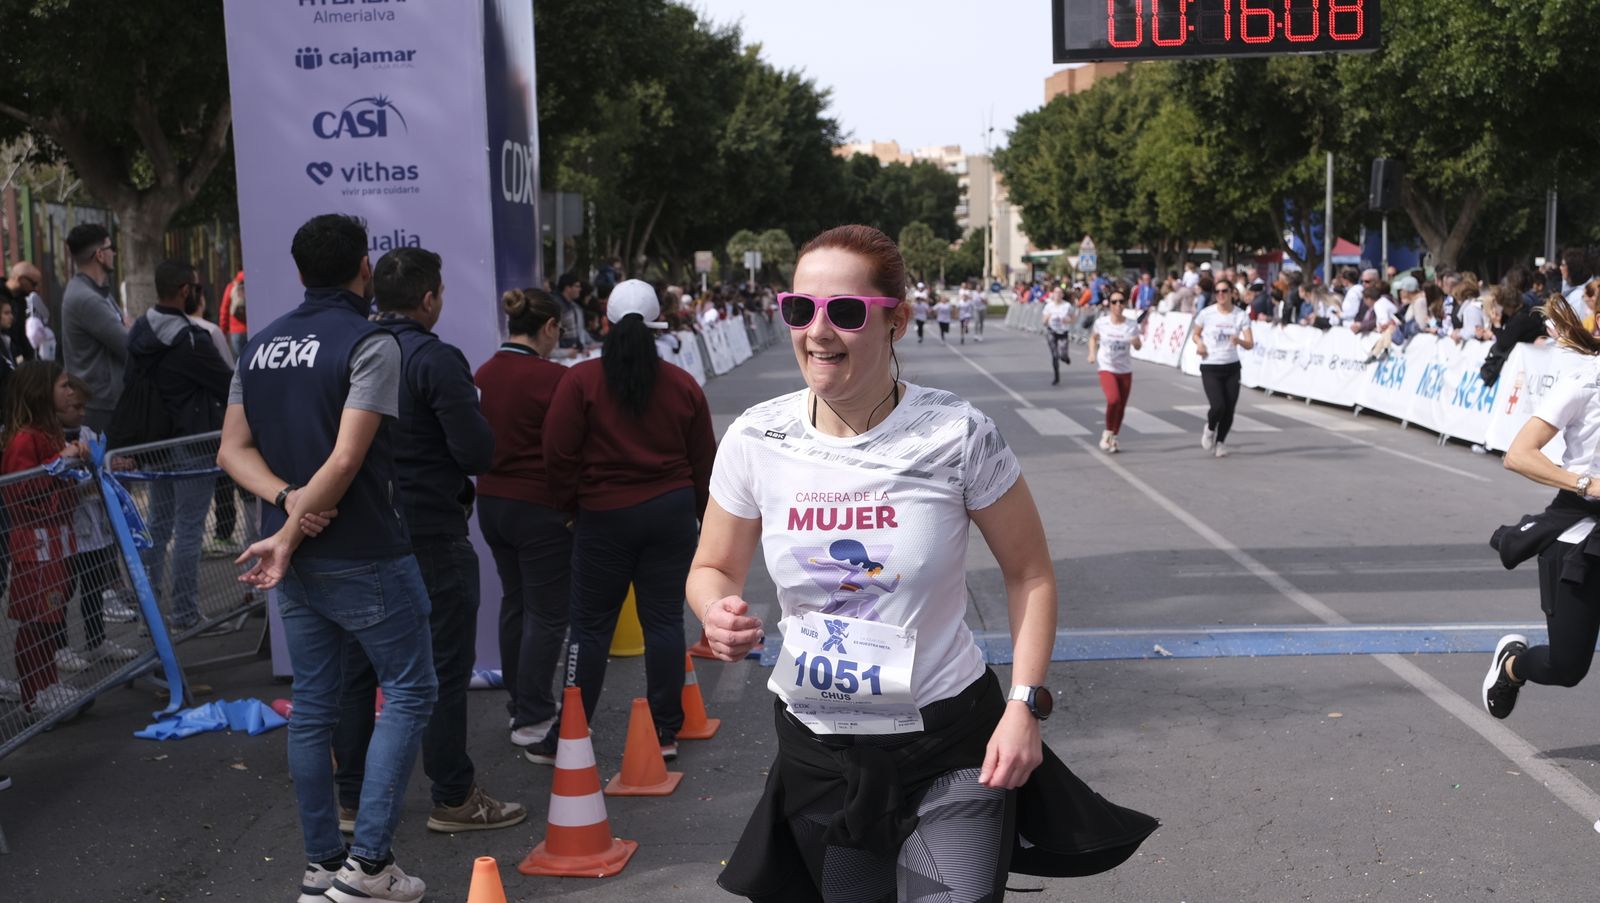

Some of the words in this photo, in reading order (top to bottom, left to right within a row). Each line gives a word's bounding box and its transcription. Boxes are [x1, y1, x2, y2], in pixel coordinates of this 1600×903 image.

[313, 8, 395, 24] Almerialva
[329, 47, 417, 69] cajamar
[312, 108, 388, 140] CASI
[341, 161, 419, 182] vithas
[502, 139, 534, 206] CDX
[362, 187, 382, 196] para
[383, 185, 420, 195] cuidarte
[795, 491, 851, 503] CARRERA
[854, 491, 870, 502] DE
[874, 490, 890, 501] LA
[787, 505, 898, 531] MUJER
[794, 651, 882, 696] 1051
[821, 691, 852, 701] CHUS
